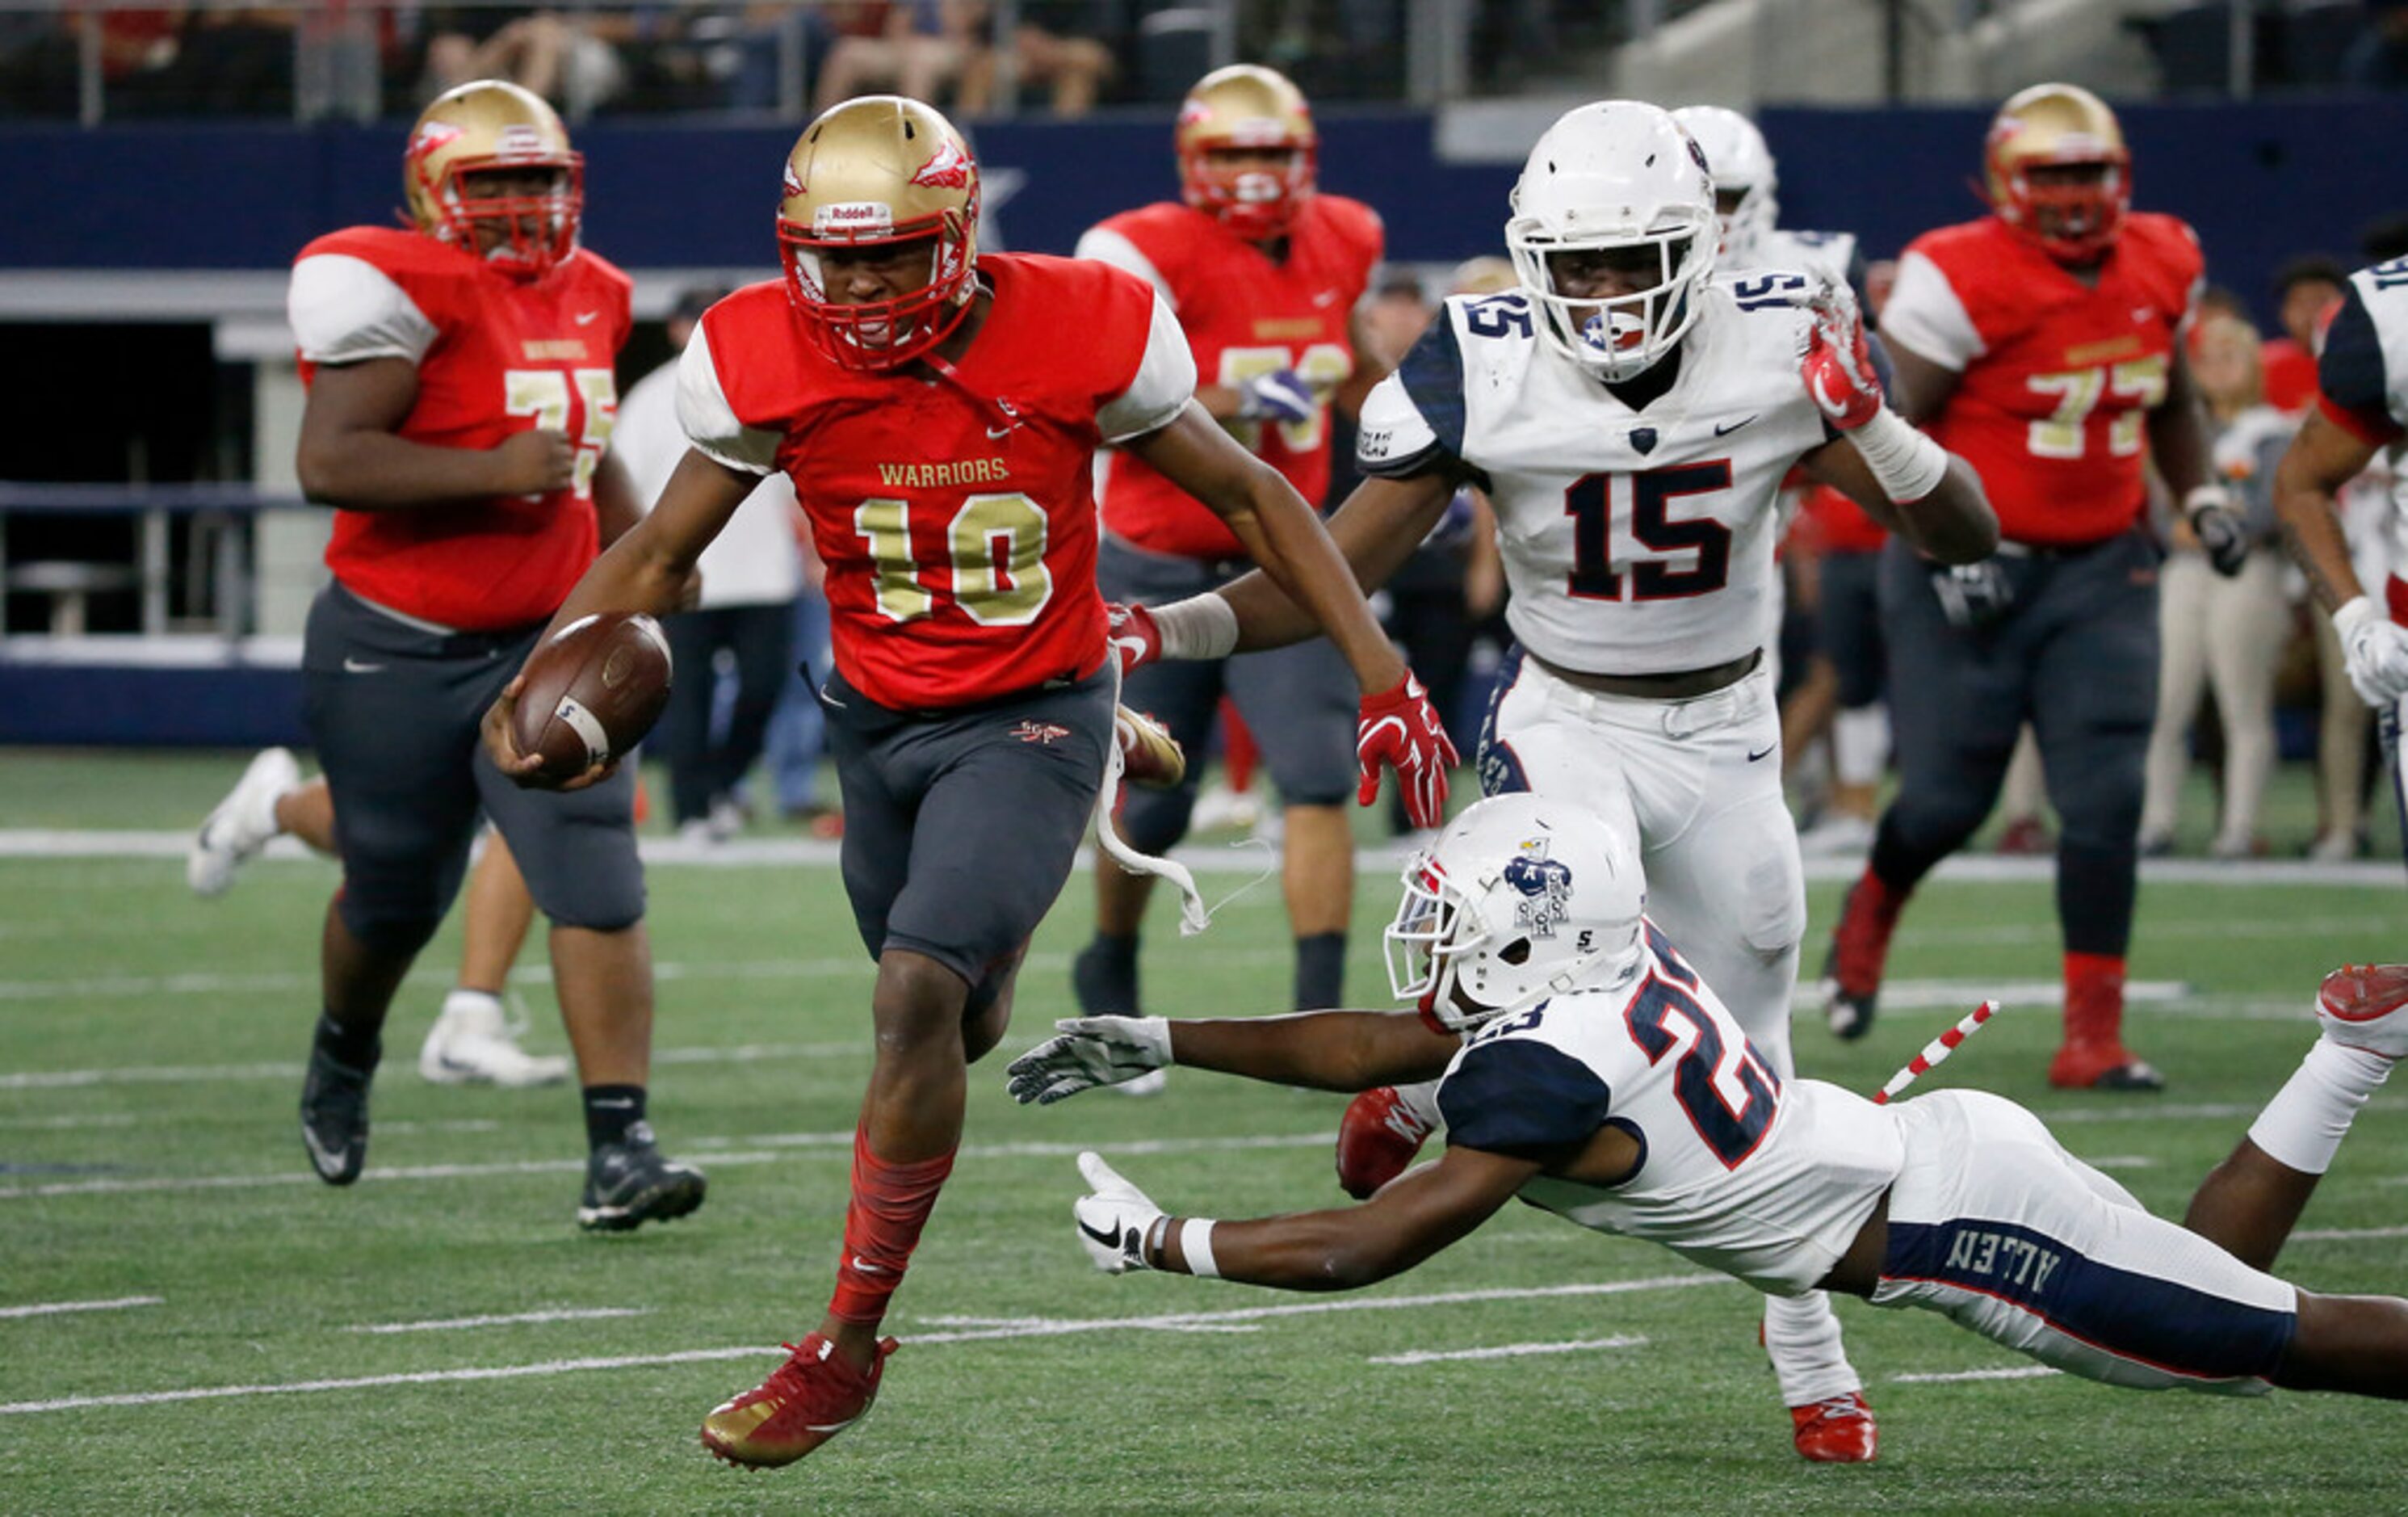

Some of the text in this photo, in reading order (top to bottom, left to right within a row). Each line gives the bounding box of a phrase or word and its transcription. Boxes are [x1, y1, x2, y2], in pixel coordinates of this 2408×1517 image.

[831, 205, 874, 220] Riddell
[1462, 296, 1533, 339] 15
[1735, 275, 1806, 313] 15
[504, 368, 619, 501] 75
[2025, 351, 2171, 460] 77
[878, 457, 1009, 488] WARRIORS
[853, 491, 1054, 627] 10
[1563, 457, 1734, 603] 15
[1945, 1229, 2062, 1293] ALLEN
